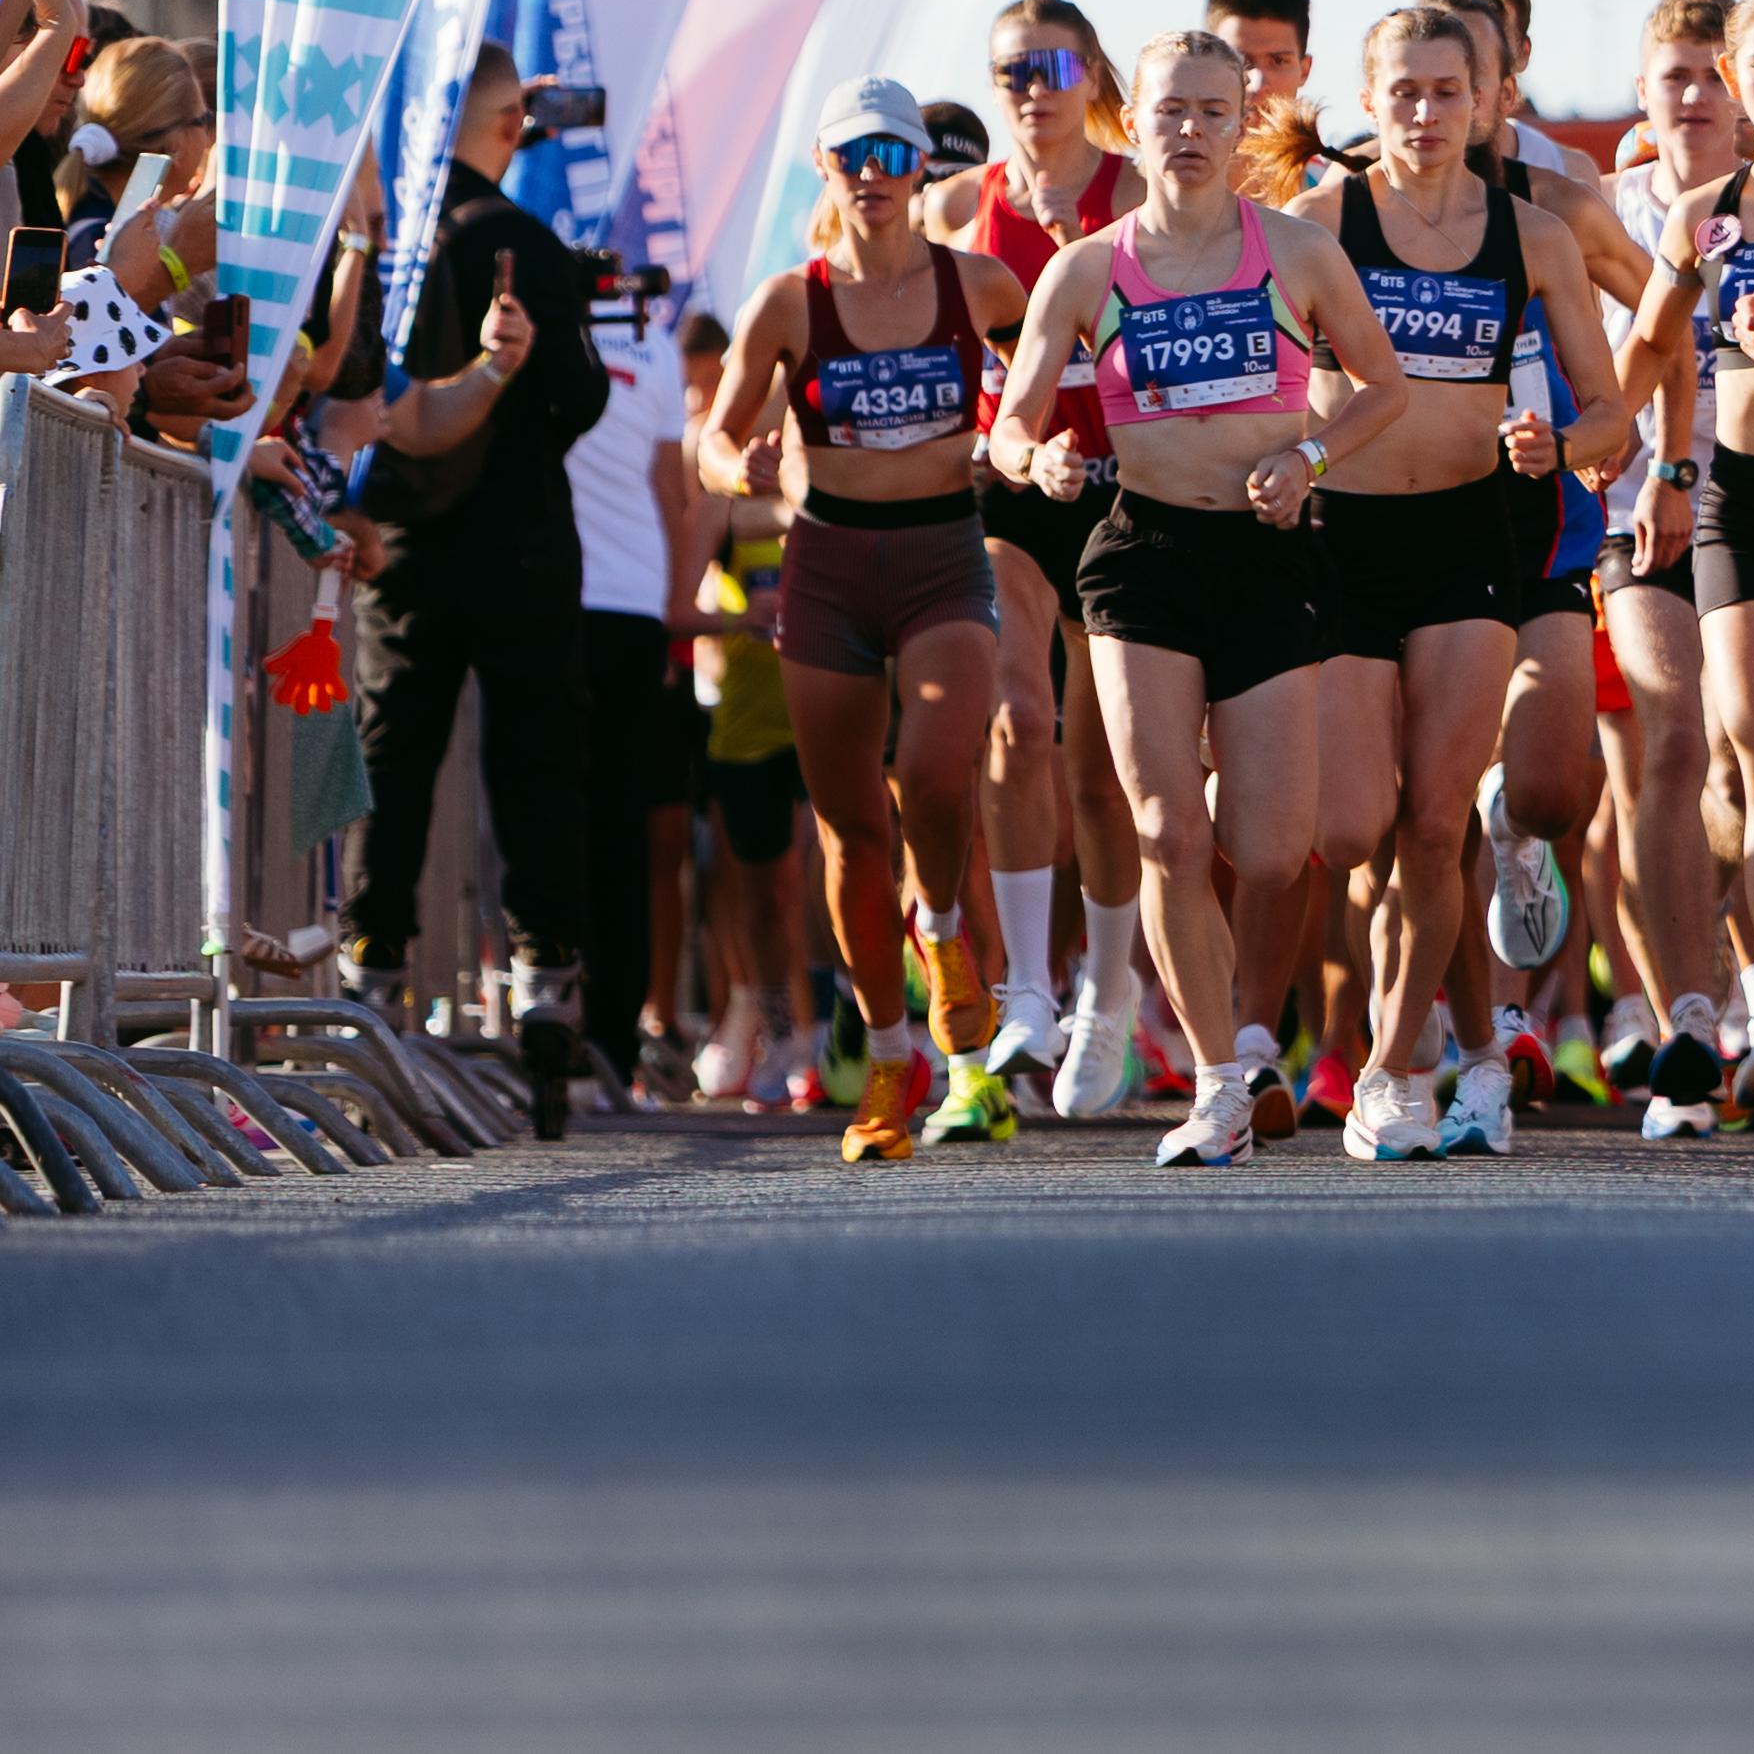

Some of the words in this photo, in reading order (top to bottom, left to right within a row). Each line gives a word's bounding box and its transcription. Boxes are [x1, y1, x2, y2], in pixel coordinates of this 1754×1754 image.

[1380, 276, 1405, 289] ВТБ
[1143, 309, 1167, 324] ВТБ
[1374, 307, 1463, 340] 17994
[1140, 333, 1235, 371] 17993
[838, 359, 862, 374] ВТБ
[851, 384, 927, 416] 4334
[856, 414, 925, 428] АНАСТАСИЯ
